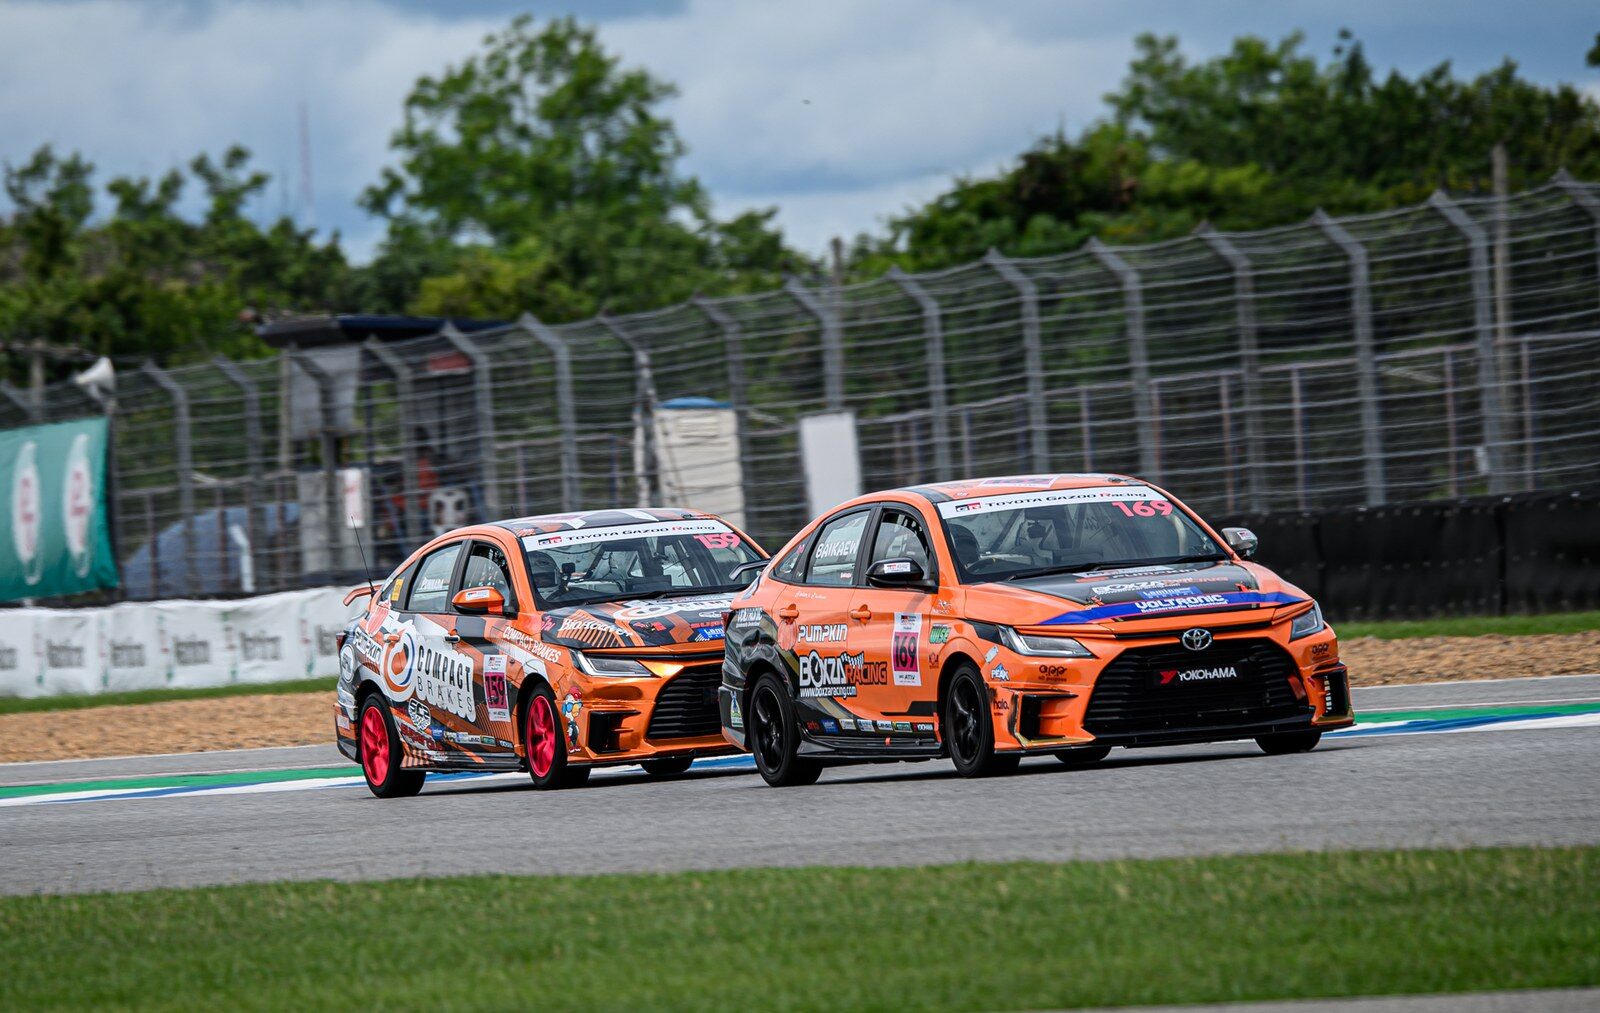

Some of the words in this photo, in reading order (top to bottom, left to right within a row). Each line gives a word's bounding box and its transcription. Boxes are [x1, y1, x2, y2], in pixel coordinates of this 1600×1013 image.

[985, 498, 1042, 508] TOYOTA
[1046, 493, 1097, 501] GAZOO
[1099, 491, 1147, 500] Racing
[1112, 500, 1174, 518] 169
[565, 531, 619, 541] TOYOTA
[622, 527, 669, 535] GAZOO
[671, 523, 715, 533] Racing
[693, 532, 741, 549] 159
[1134, 594, 1225, 609] VOLTRONIC
[797, 624, 848, 643] PUMPKIN
[503, 626, 534, 651] COMPACT
[531, 640, 562, 663] BRAKES
[893, 635, 917, 669] 169
[416, 645, 471, 692] COMPACT
[799, 650, 847, 688] BOXZA
[845, 661, 888, 686] RACING
[991, 669, 1010, 681] PEAK
[1178, 666, 1238, 682] YOKOHAMA
[416, 675, 473, 713] BRAKES
[484, 675, 507, 707] 159
